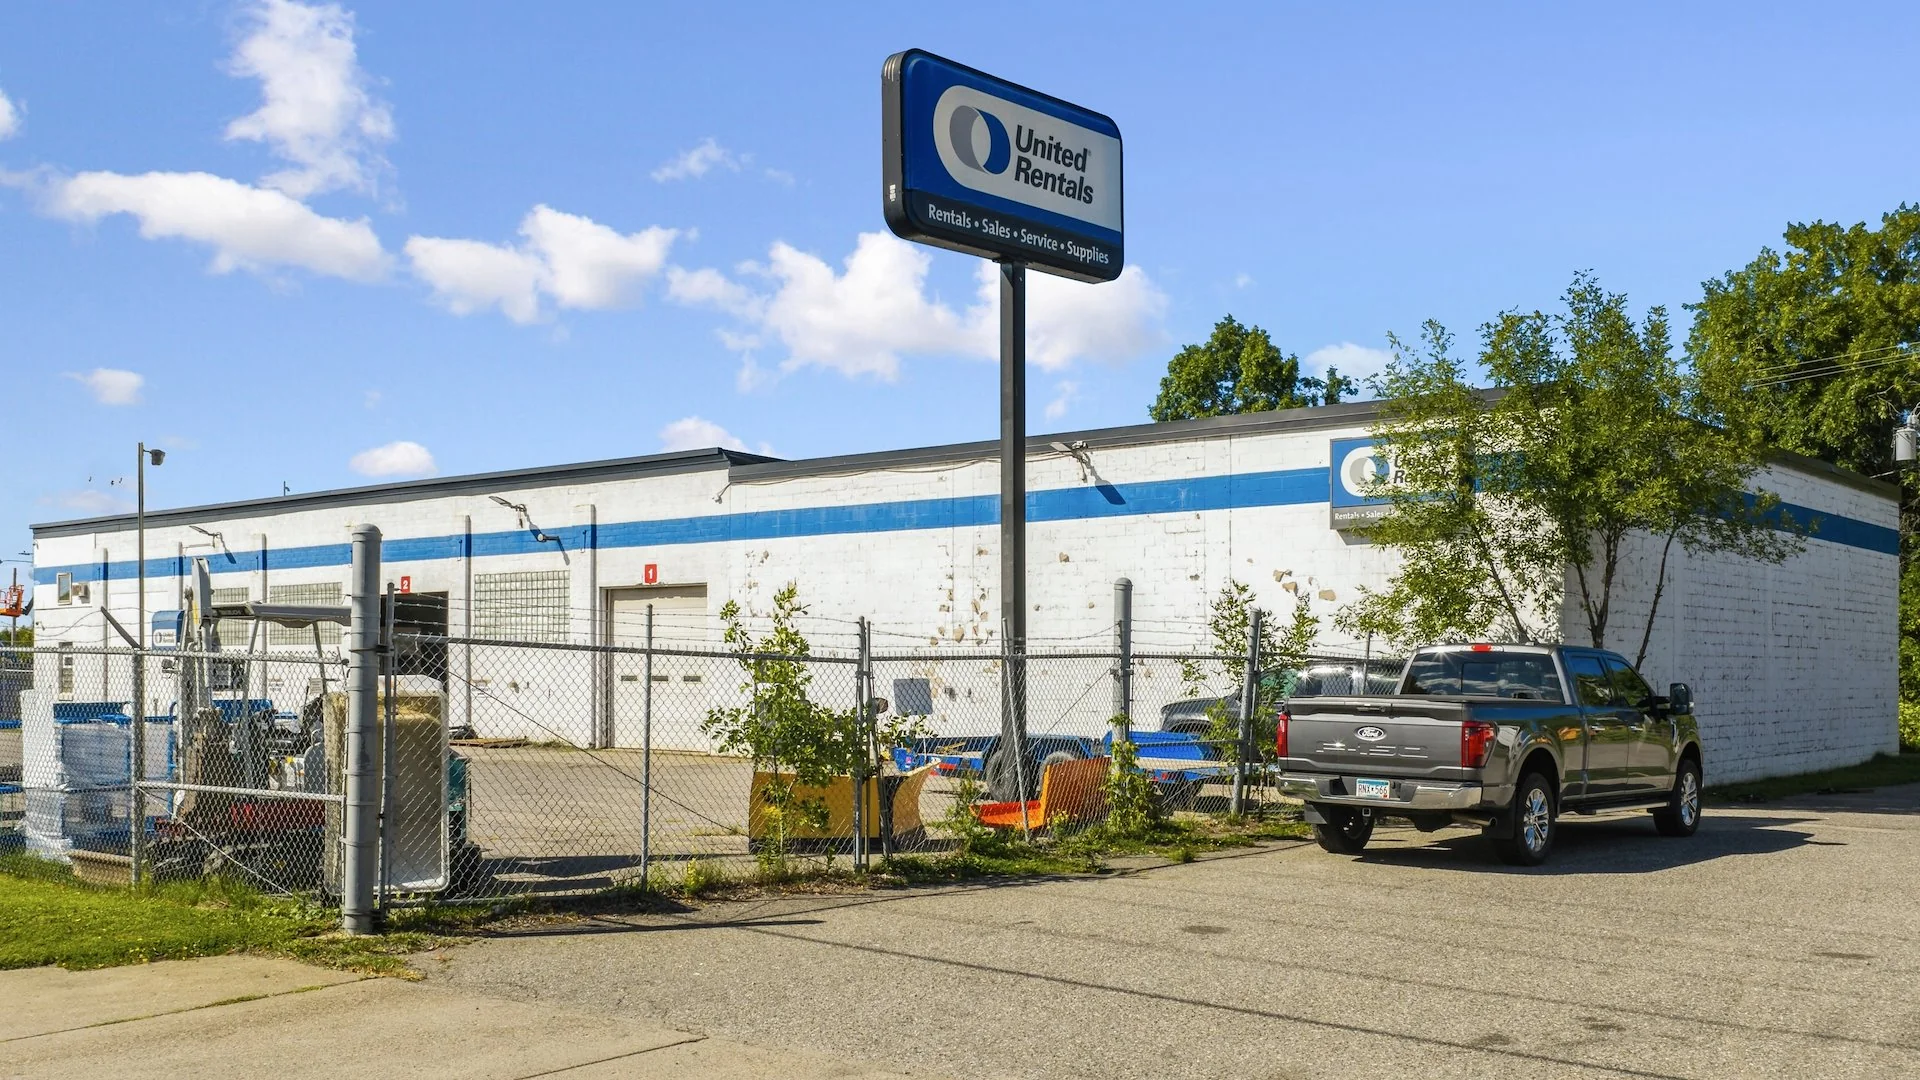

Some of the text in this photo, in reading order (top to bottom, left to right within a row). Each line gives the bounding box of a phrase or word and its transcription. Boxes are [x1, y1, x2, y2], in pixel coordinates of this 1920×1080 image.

[1015, 124, 1088, 173] United
[1014, 155, 1094, 204] Rentals
[928, 203, 1109, 264] Rentals Sales Service Supplies
[1334, 511, 1360, 520] Rentals
[1366, 510, 1384, 519] Sales
[402, 579, 409, 589] 2
[648, 568, 653, 579] 1
